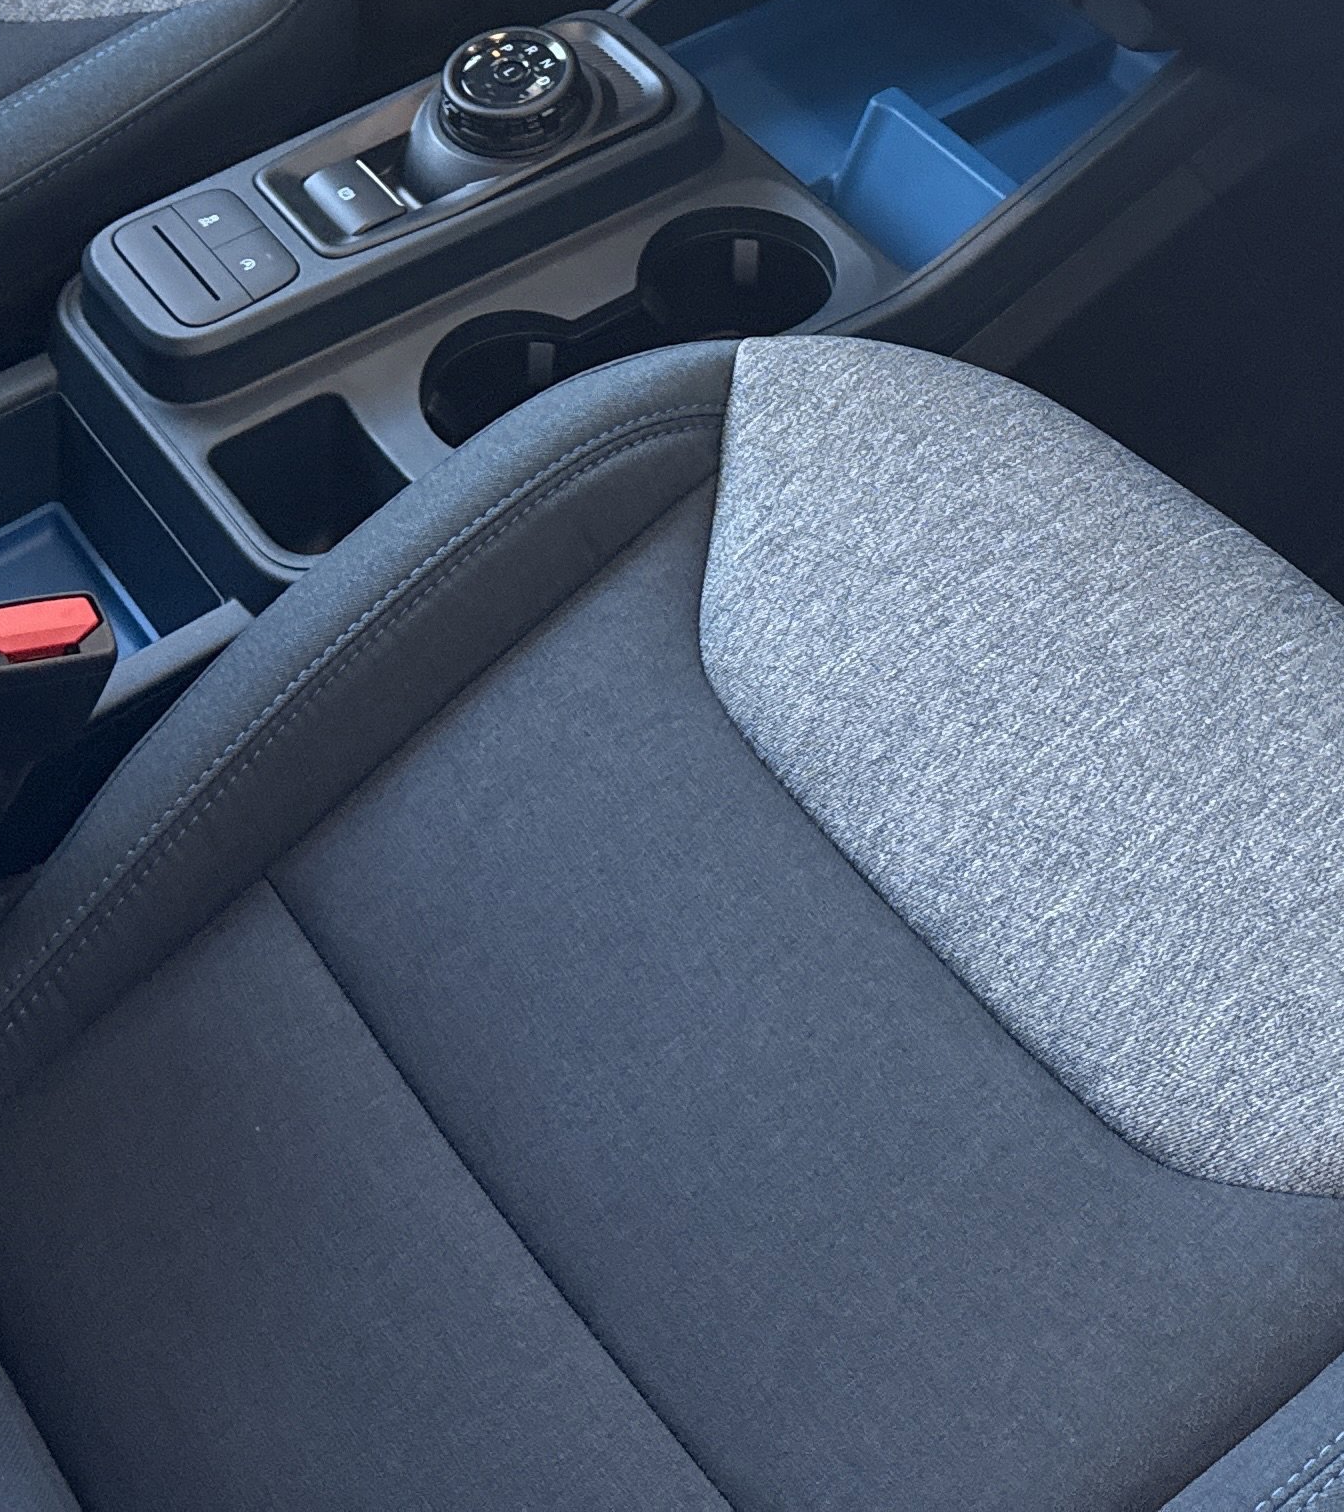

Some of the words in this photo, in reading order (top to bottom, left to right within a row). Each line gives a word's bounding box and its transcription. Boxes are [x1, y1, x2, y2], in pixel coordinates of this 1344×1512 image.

[499, 44, 514, 52] P
[524, 45, 539, 56] R
[539, 58, 555, 69] N
[502, 67, 515, 77] L
[536, 76, 551, 87] D
